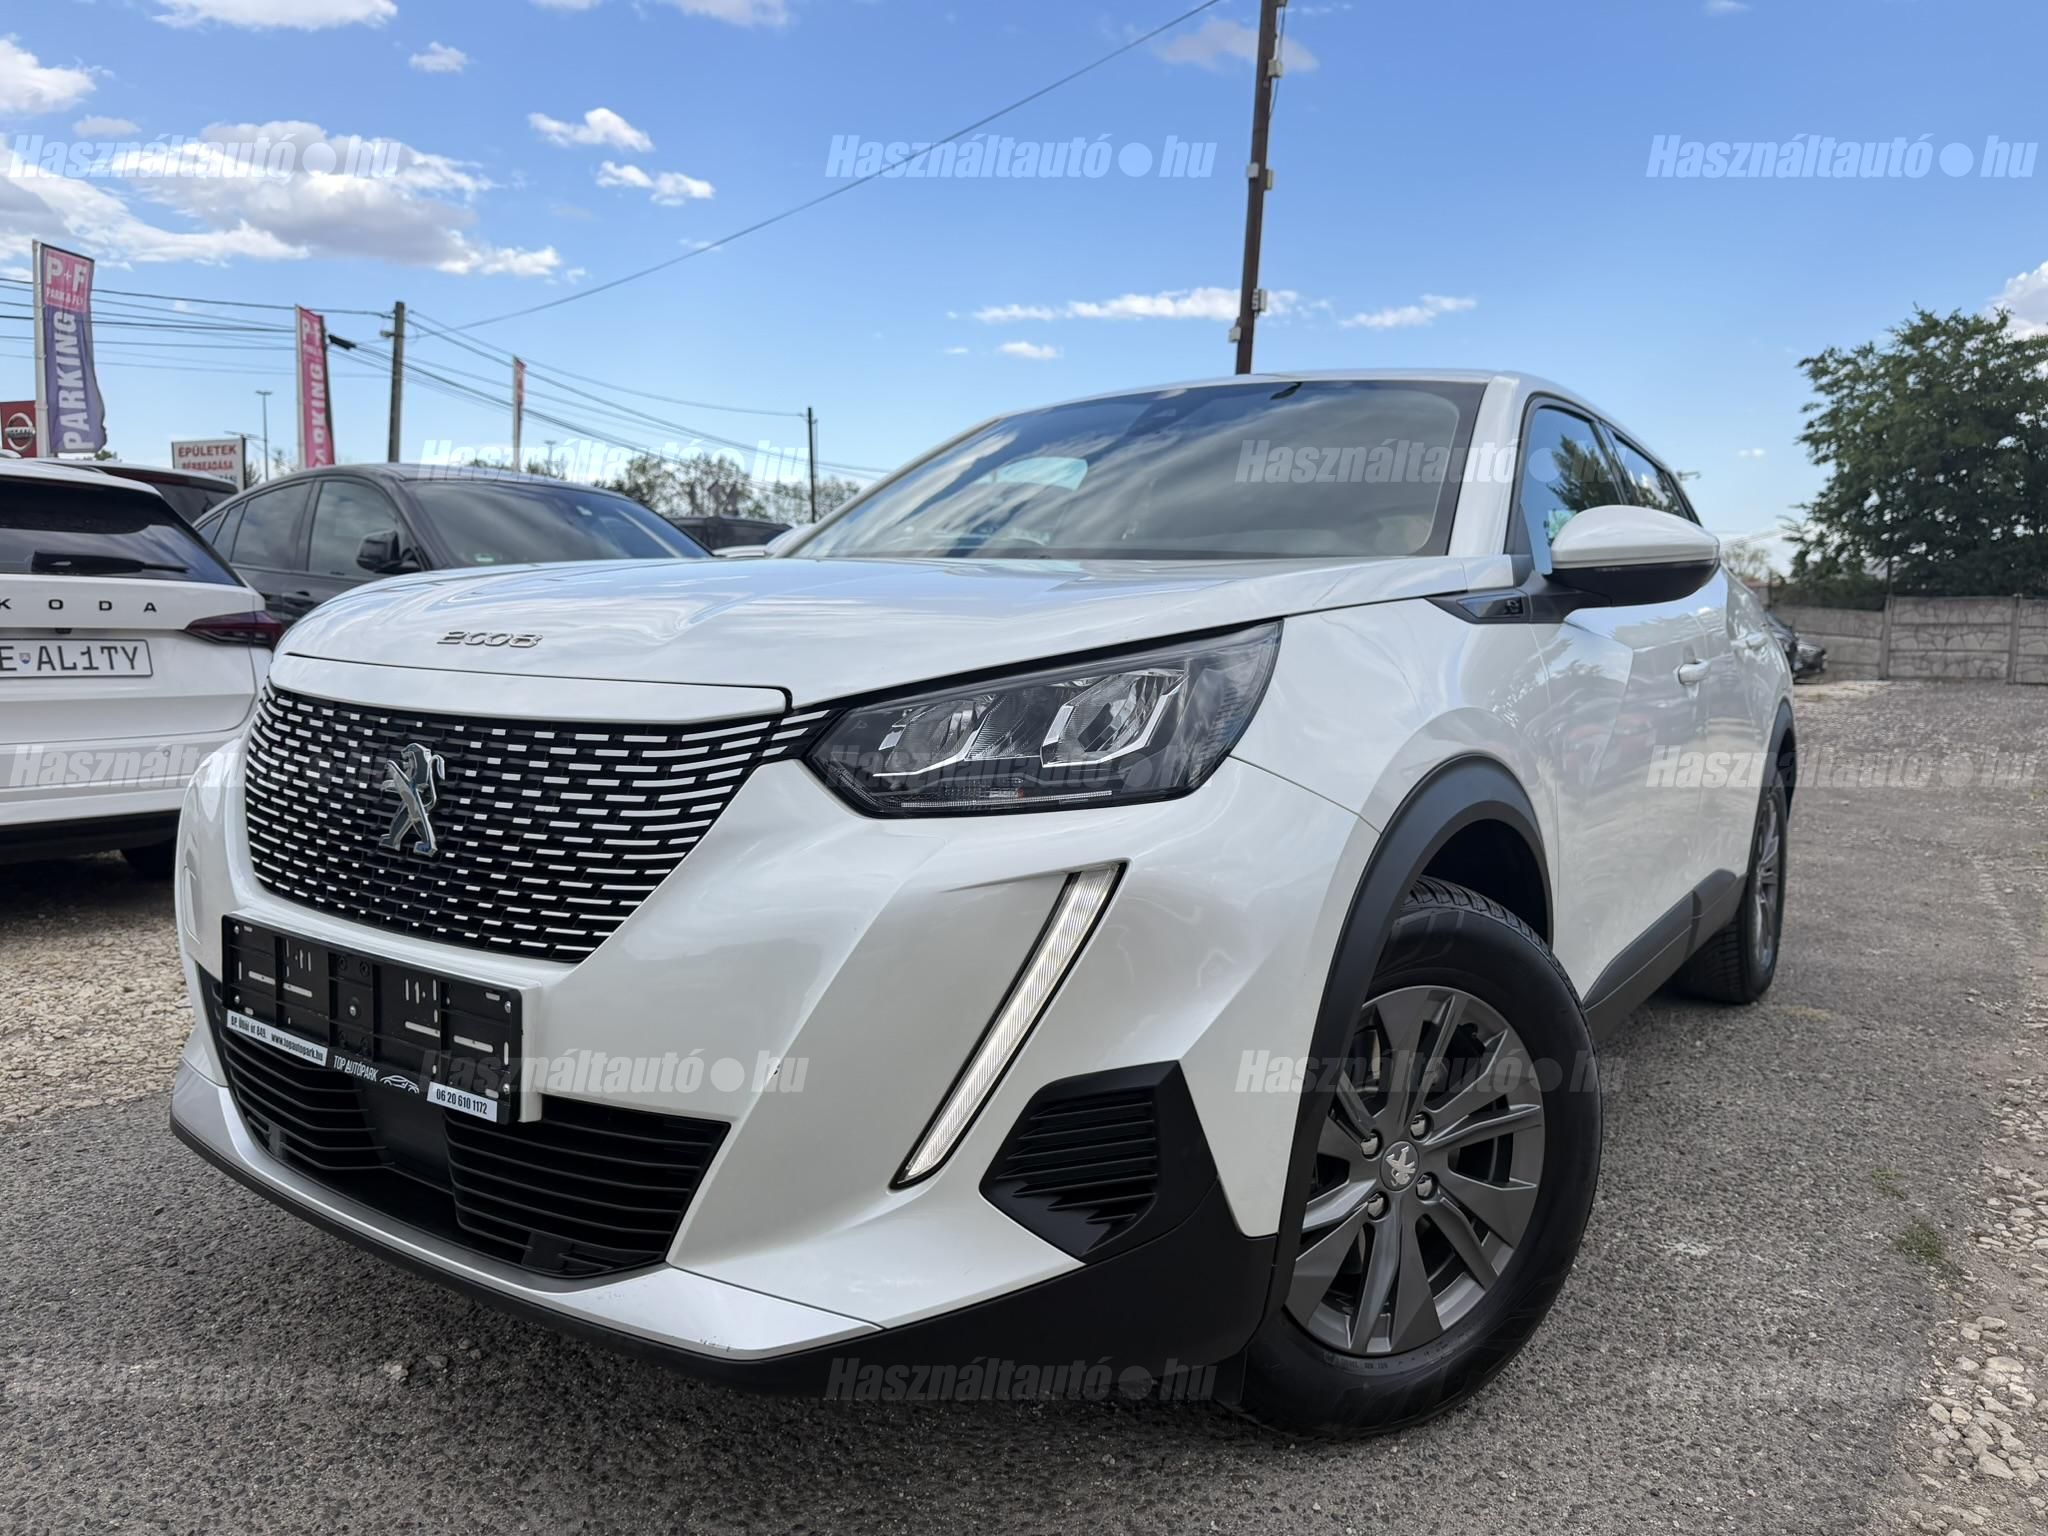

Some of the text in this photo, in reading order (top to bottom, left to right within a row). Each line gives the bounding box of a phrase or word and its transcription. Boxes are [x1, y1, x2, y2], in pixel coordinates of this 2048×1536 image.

[53, 311, 95, 450] PARKING
[333, 1055, 346, 1070] TOP
[436, 1088, 488, 1115] 06 20 610 1172
